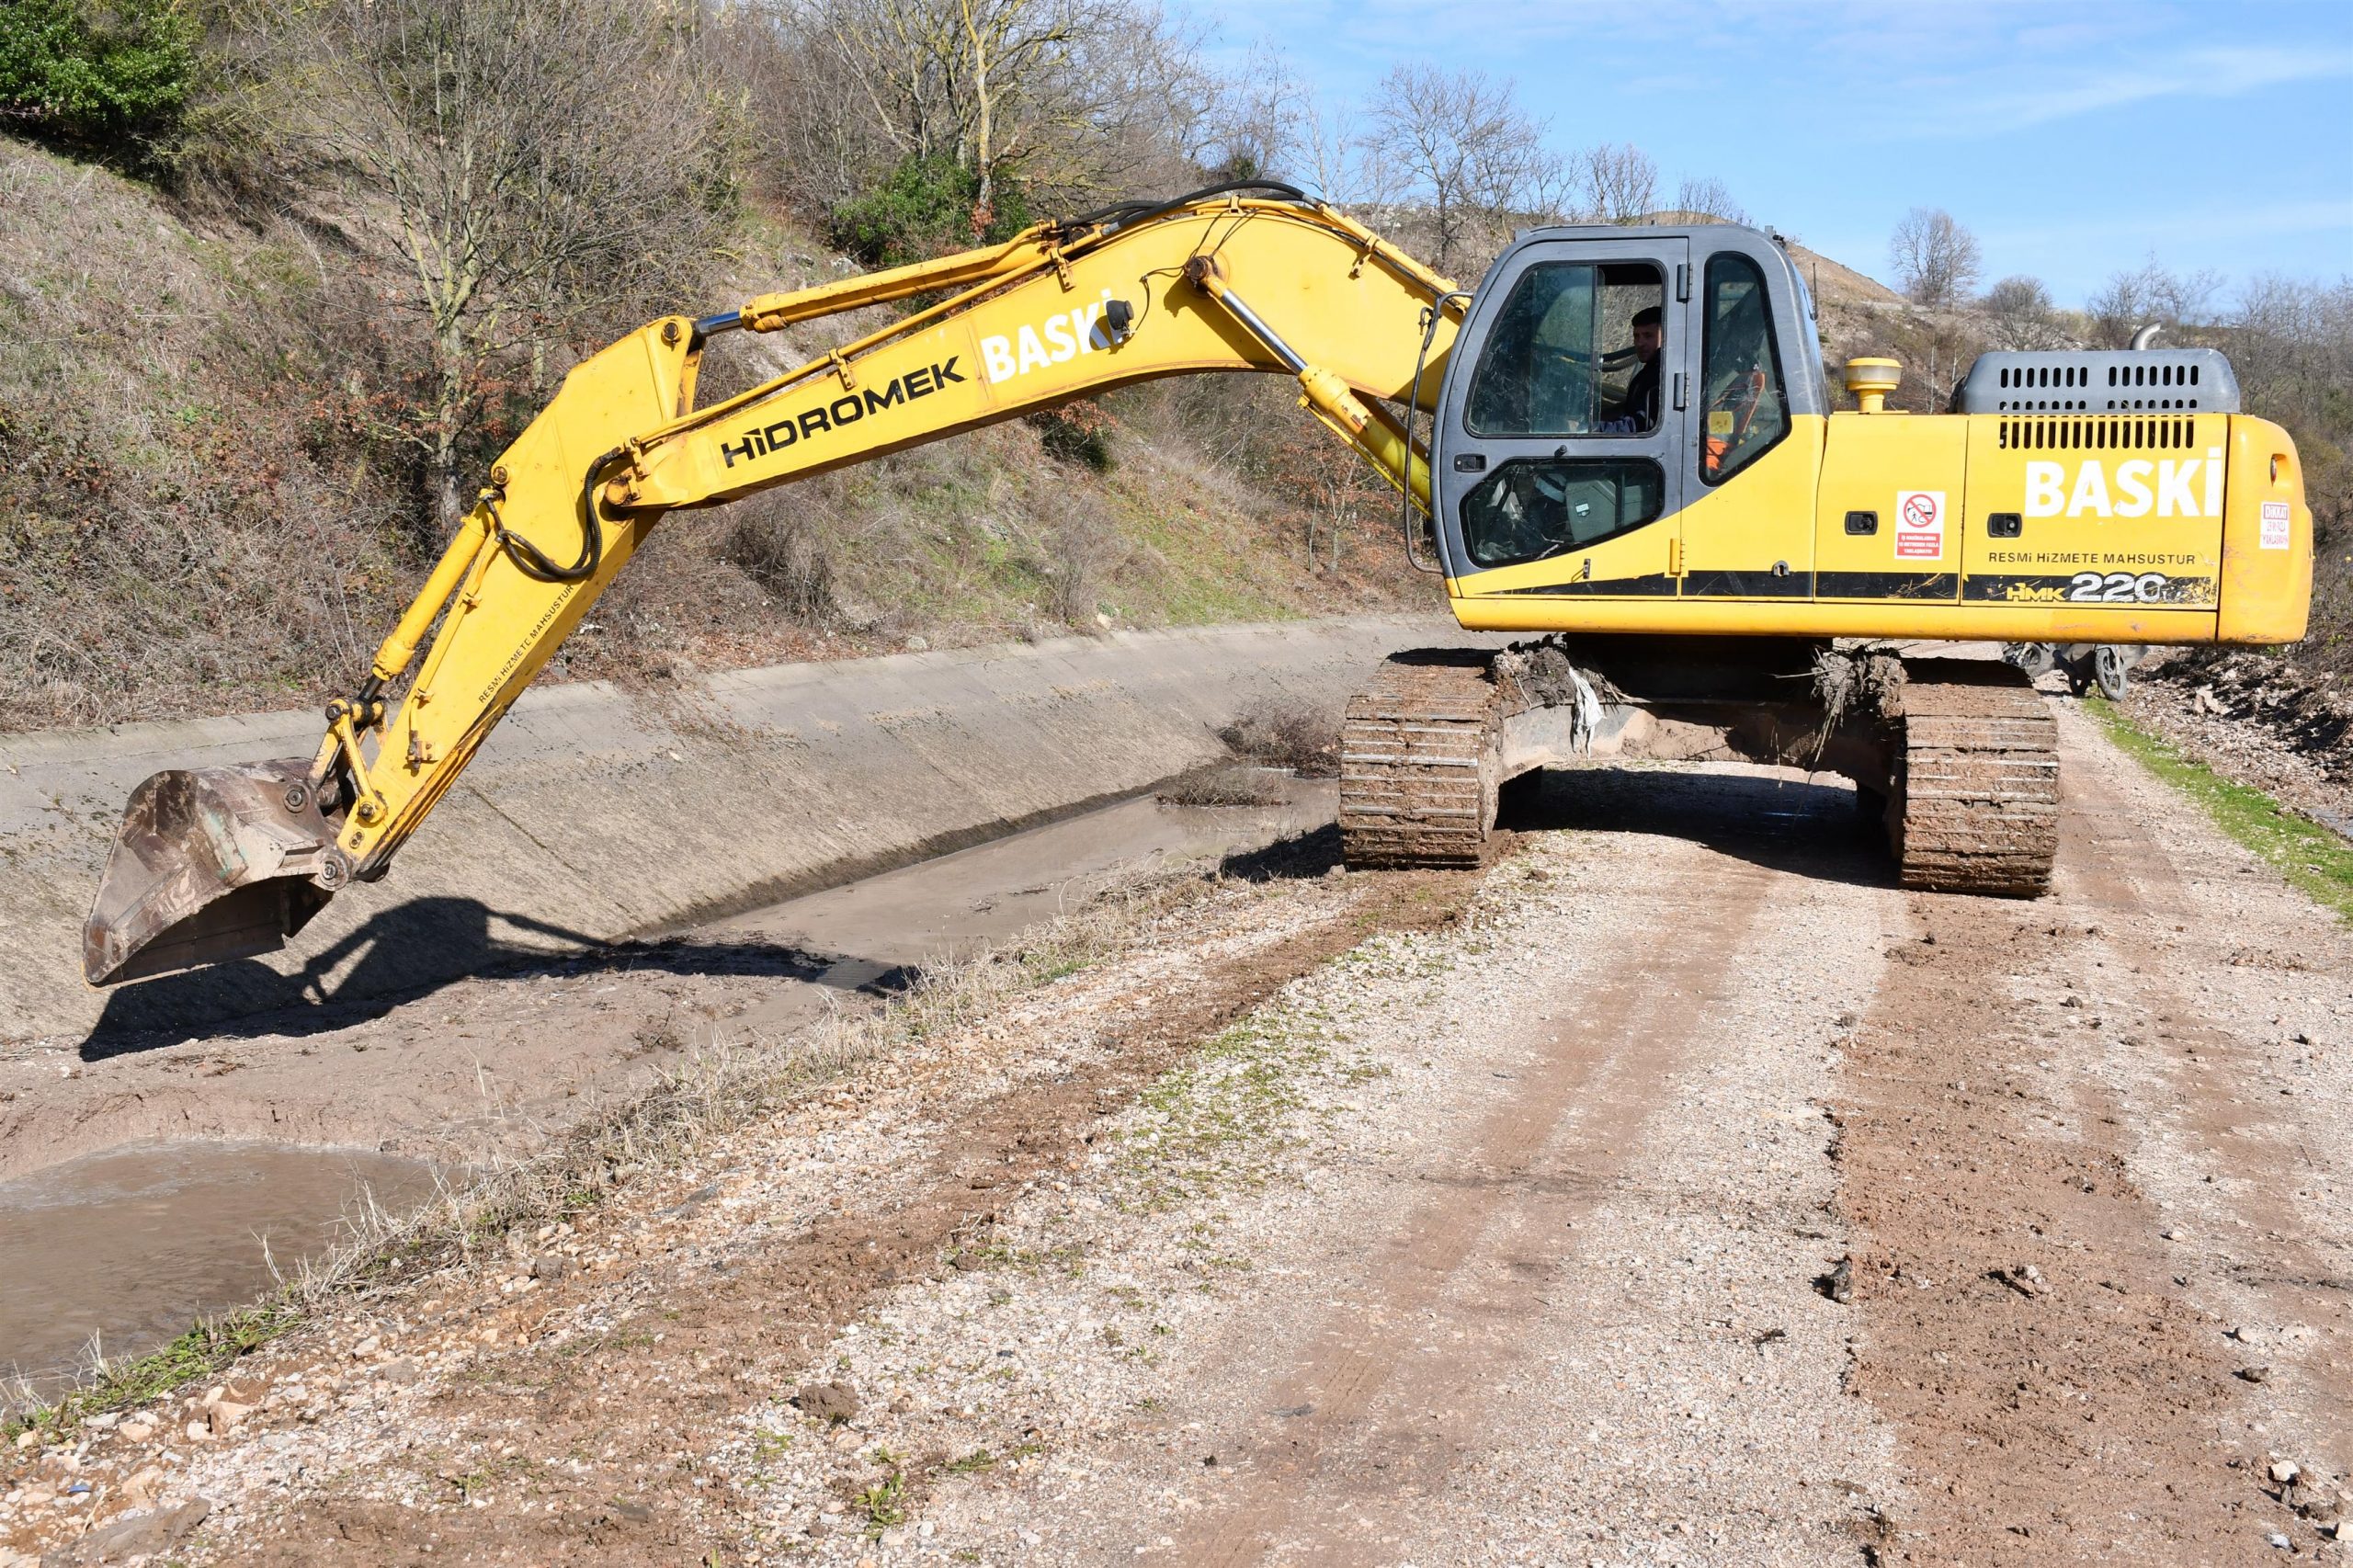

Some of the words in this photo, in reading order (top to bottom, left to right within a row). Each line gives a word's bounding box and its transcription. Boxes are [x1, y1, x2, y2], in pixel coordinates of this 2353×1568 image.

[2024, 447, 2222, 517] BASKİ
[2103, 553, 2196, 564] MAHSUSTUR
[2070, 573, 2166, 602] 220
[529, 584, 574, 639] MAHSUSTUR
